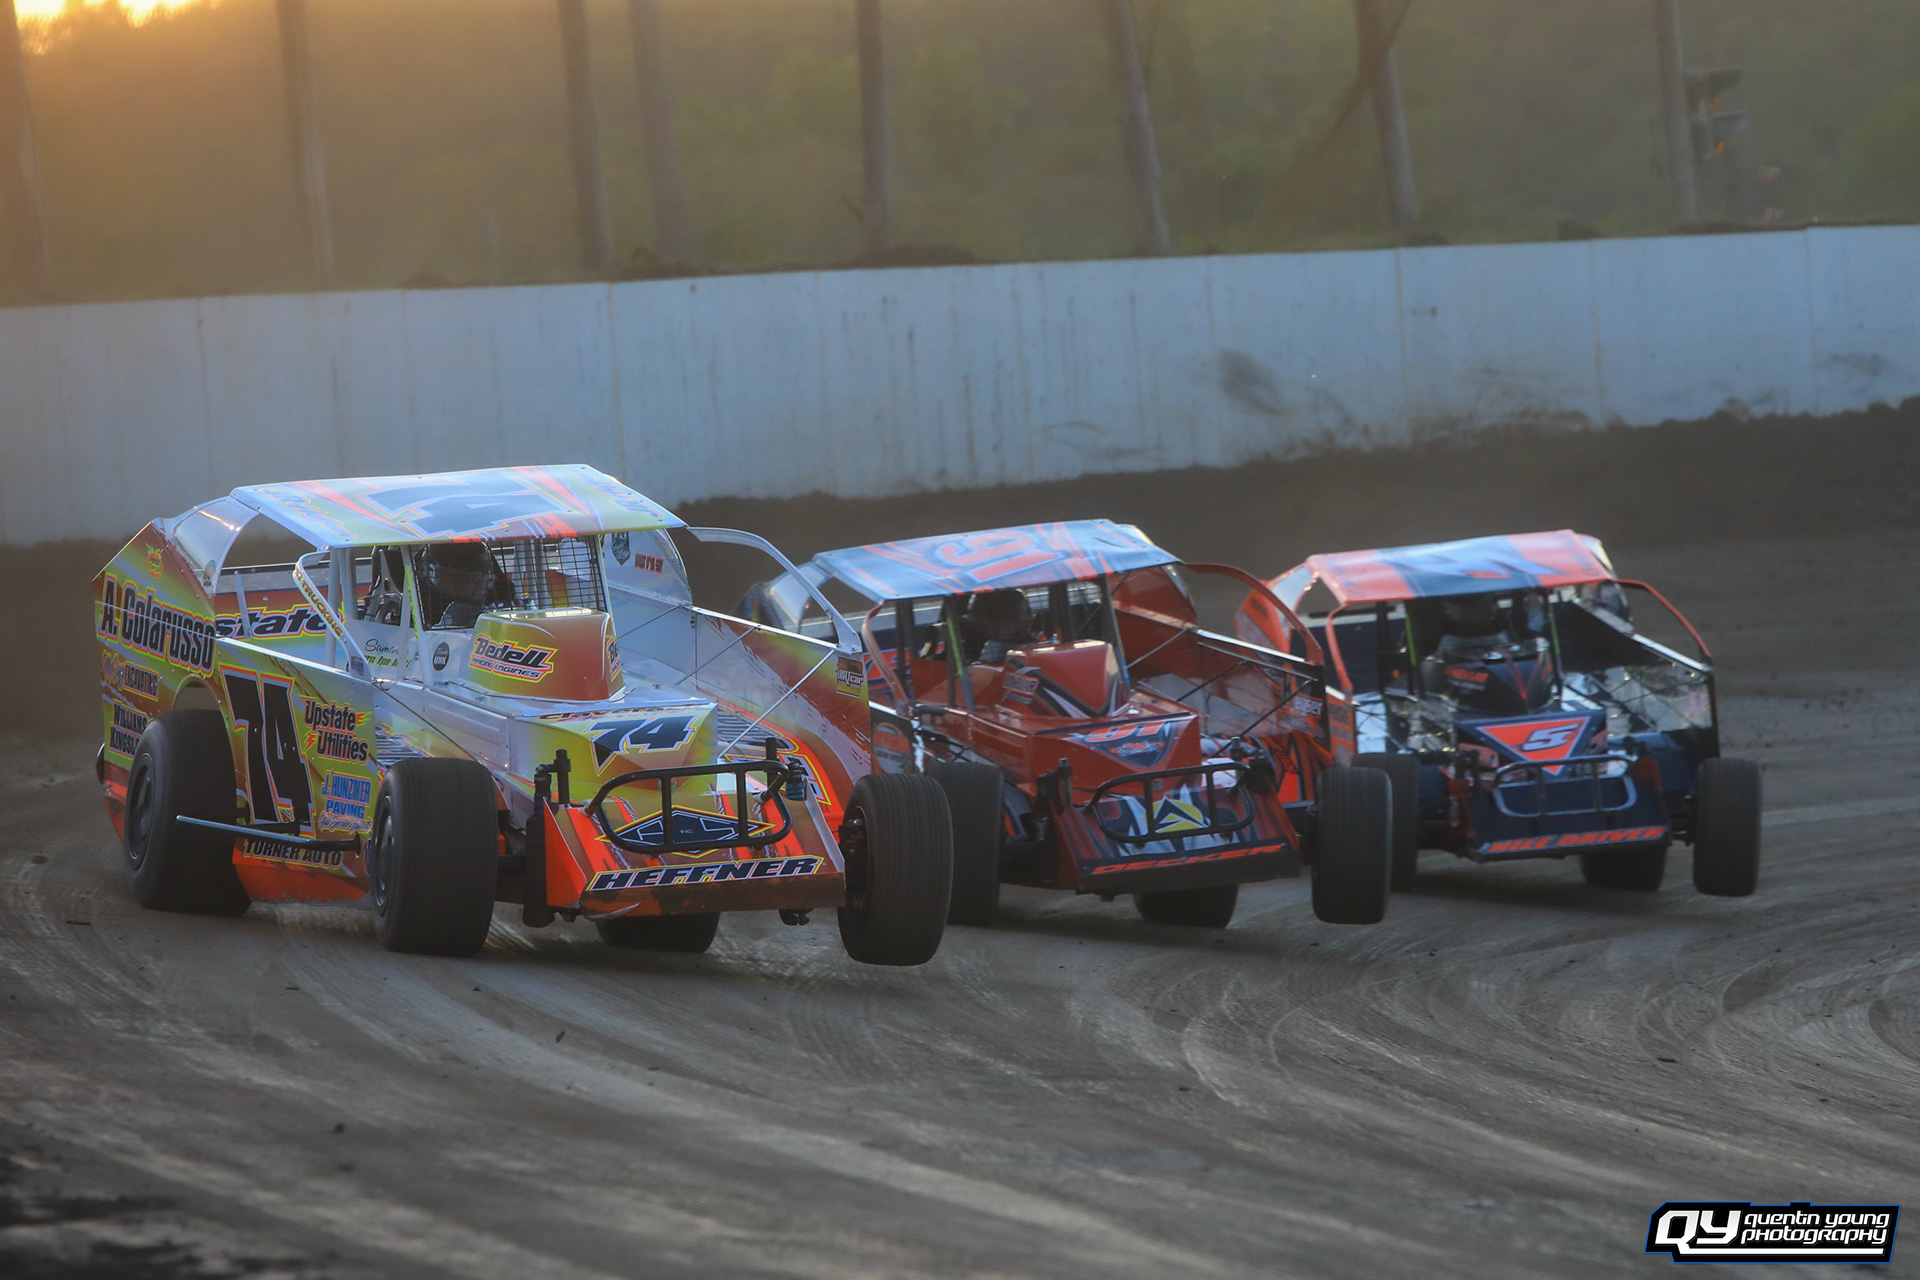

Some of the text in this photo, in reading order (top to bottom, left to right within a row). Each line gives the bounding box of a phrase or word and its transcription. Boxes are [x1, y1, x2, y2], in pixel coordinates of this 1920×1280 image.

[100, 579, 118, 637] A.
[121, 585, 216, 671] Colarusso
[472, 657, 540, 678] RACING ENGINES
[475, 636, 552, 668] Bedell
[304, 699, 356, 732] Upstate
[223, 670, 316, 834] 74
[316, 728, 368, 762] Utilities
[586, 714, 696, 770] 74
[1517, 722, 1582, 752] 5
[321, 773, 330, 796] J.
[325, 799, 366, 820] PAVING
[1556, 827, 1666, 847] DRIVER
[244, 840, 299, 864] TURNER
[301, 850, 343, 867] AUTO
[1091, 844, 1284, 875] DECKER
[590, 857, 819, 890] HEFFNER
